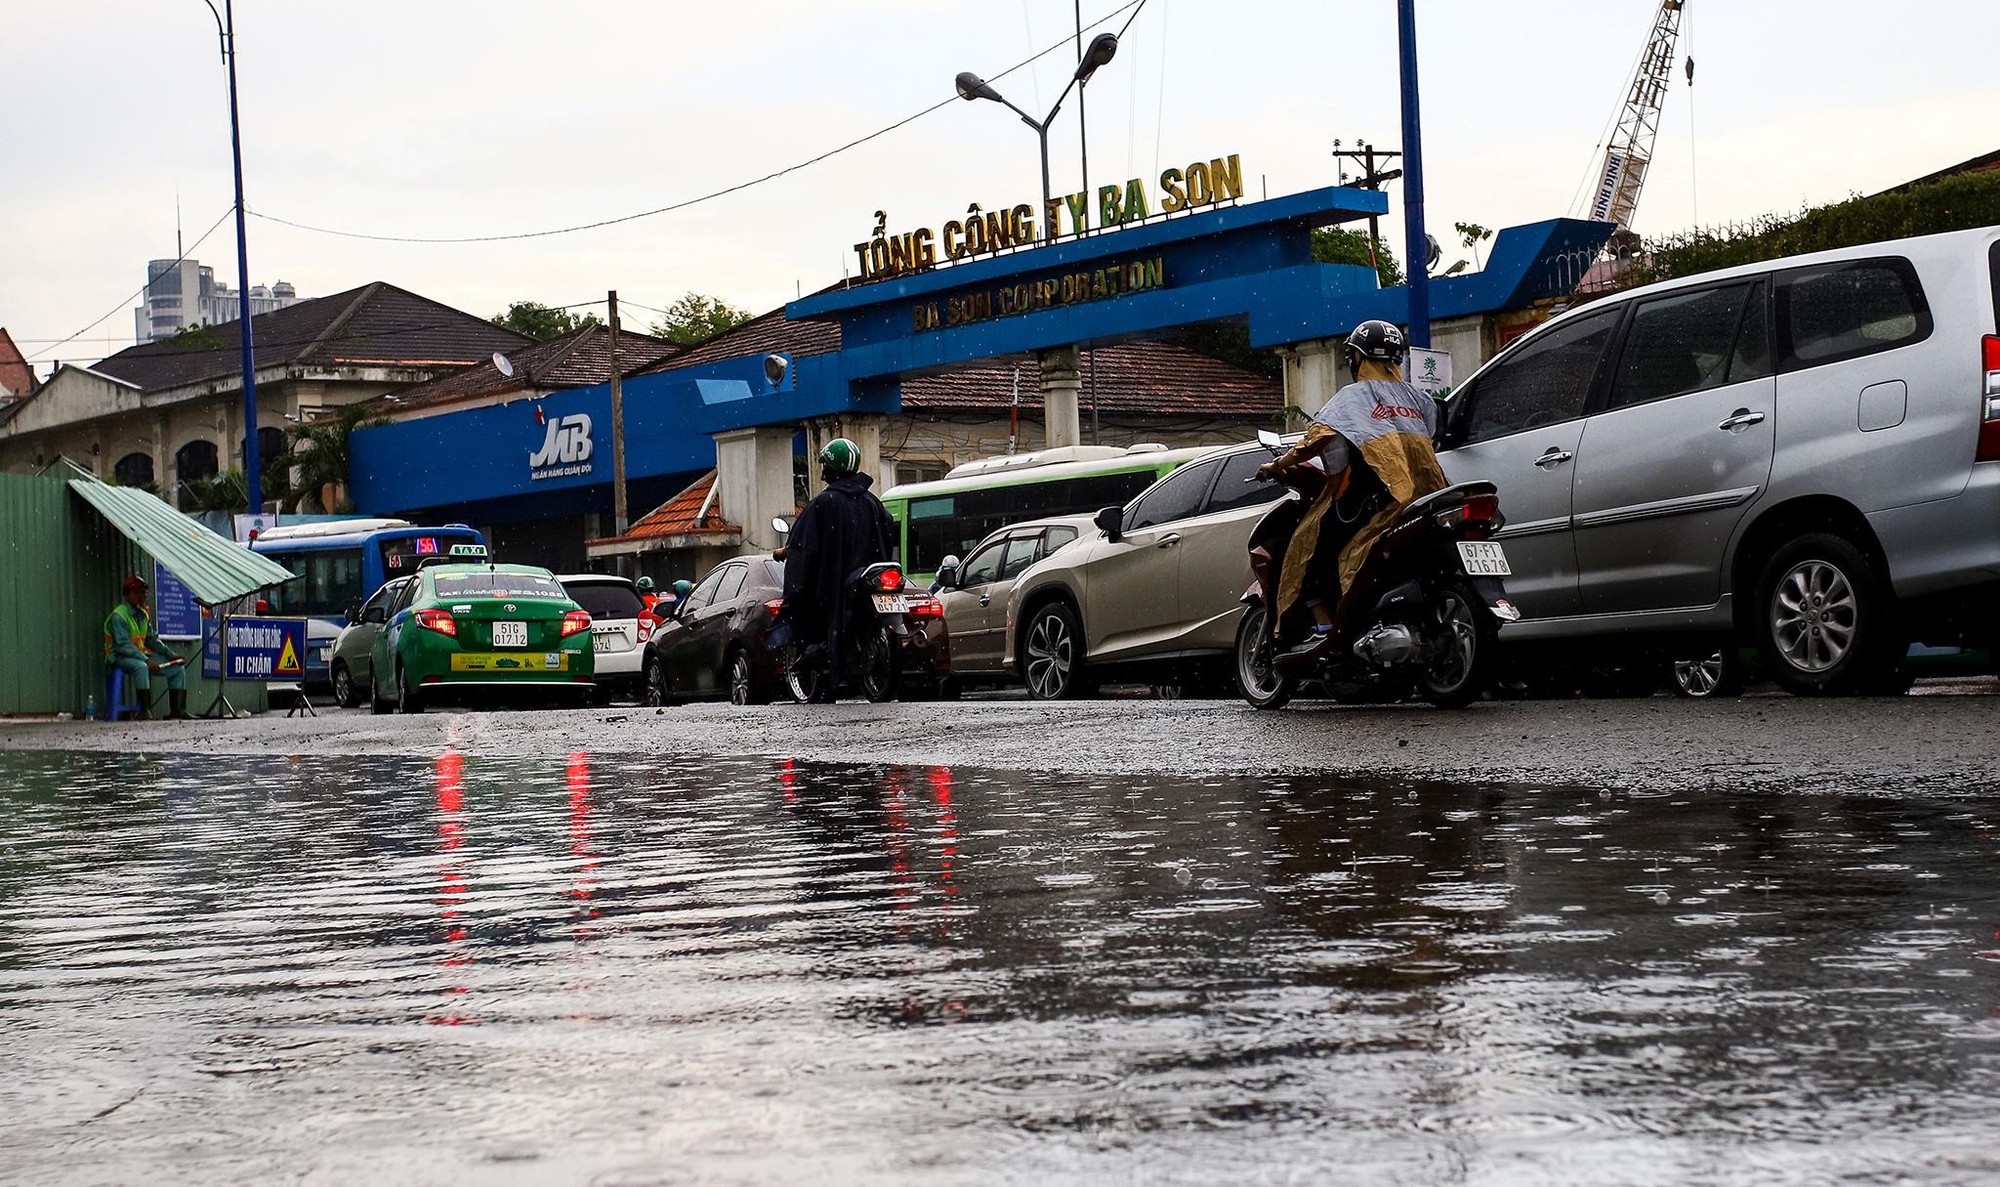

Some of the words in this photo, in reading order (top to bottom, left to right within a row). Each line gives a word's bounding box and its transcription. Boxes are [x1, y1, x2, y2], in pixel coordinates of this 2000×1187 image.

[854, 210, 936, 279] TỔNG
[943, 202, 1036, 260] CÔNG
[1045, 191, 1088, 239] TY
[1098, 178, 1149, 228] BA
[1160, 154, 1243, 213] SON
[913, 302, 941, 331] BA
[947, 291, 992, 324] SON
[999, 257, 1163, 314] CORPORATION
[420, 538, 434, 554] 56
[459, 546, 480, 554] TAXI
[1465, 544, 1498, 558] 67-F1
[1466, 560, 1508, 573] 216.78
[501, 623, 519, 634] 51G
[494, 634, 526, 645] 017.12
[235, 656, 245, 674] ĐI
[246, 652, 272, 678] CHẬM
